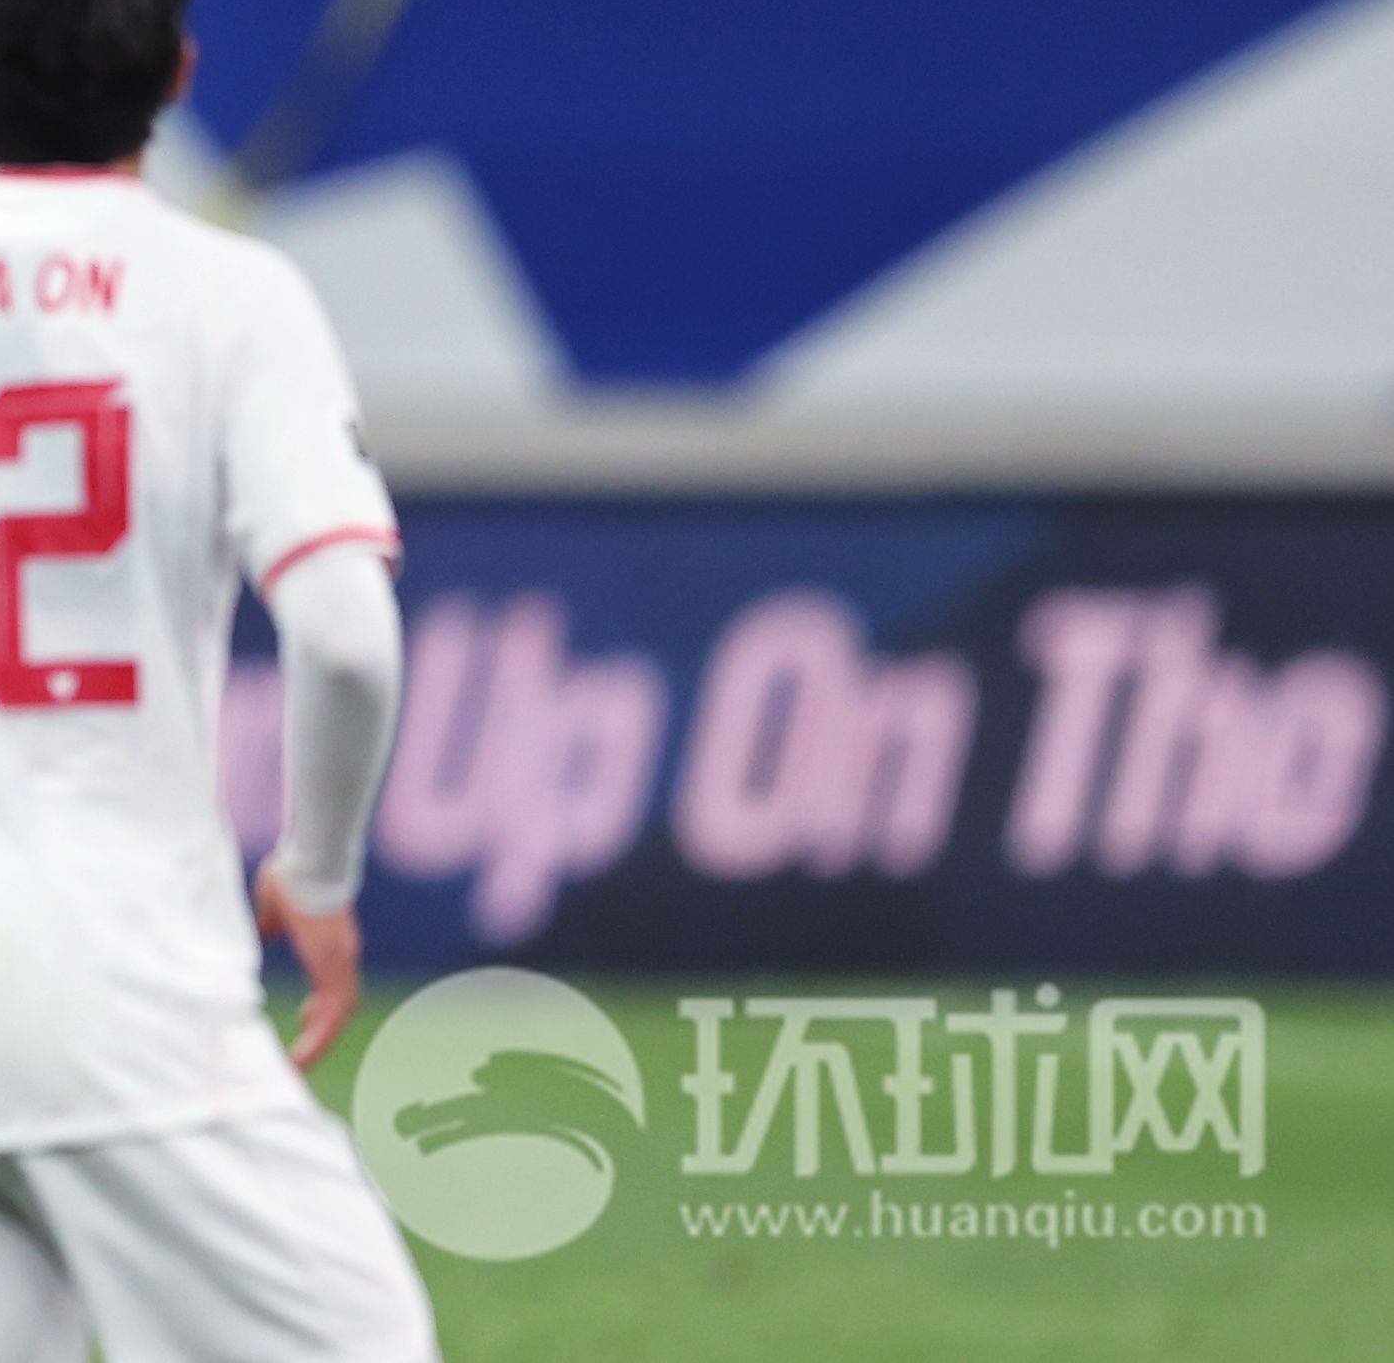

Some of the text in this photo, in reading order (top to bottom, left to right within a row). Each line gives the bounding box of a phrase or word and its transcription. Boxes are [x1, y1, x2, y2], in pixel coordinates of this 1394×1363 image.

[34, 250, 124, 315] ON
[379, 594, 669, 944] Up
[674, 589, 981, 878] On
[1009, 582, 1389, 880] The
